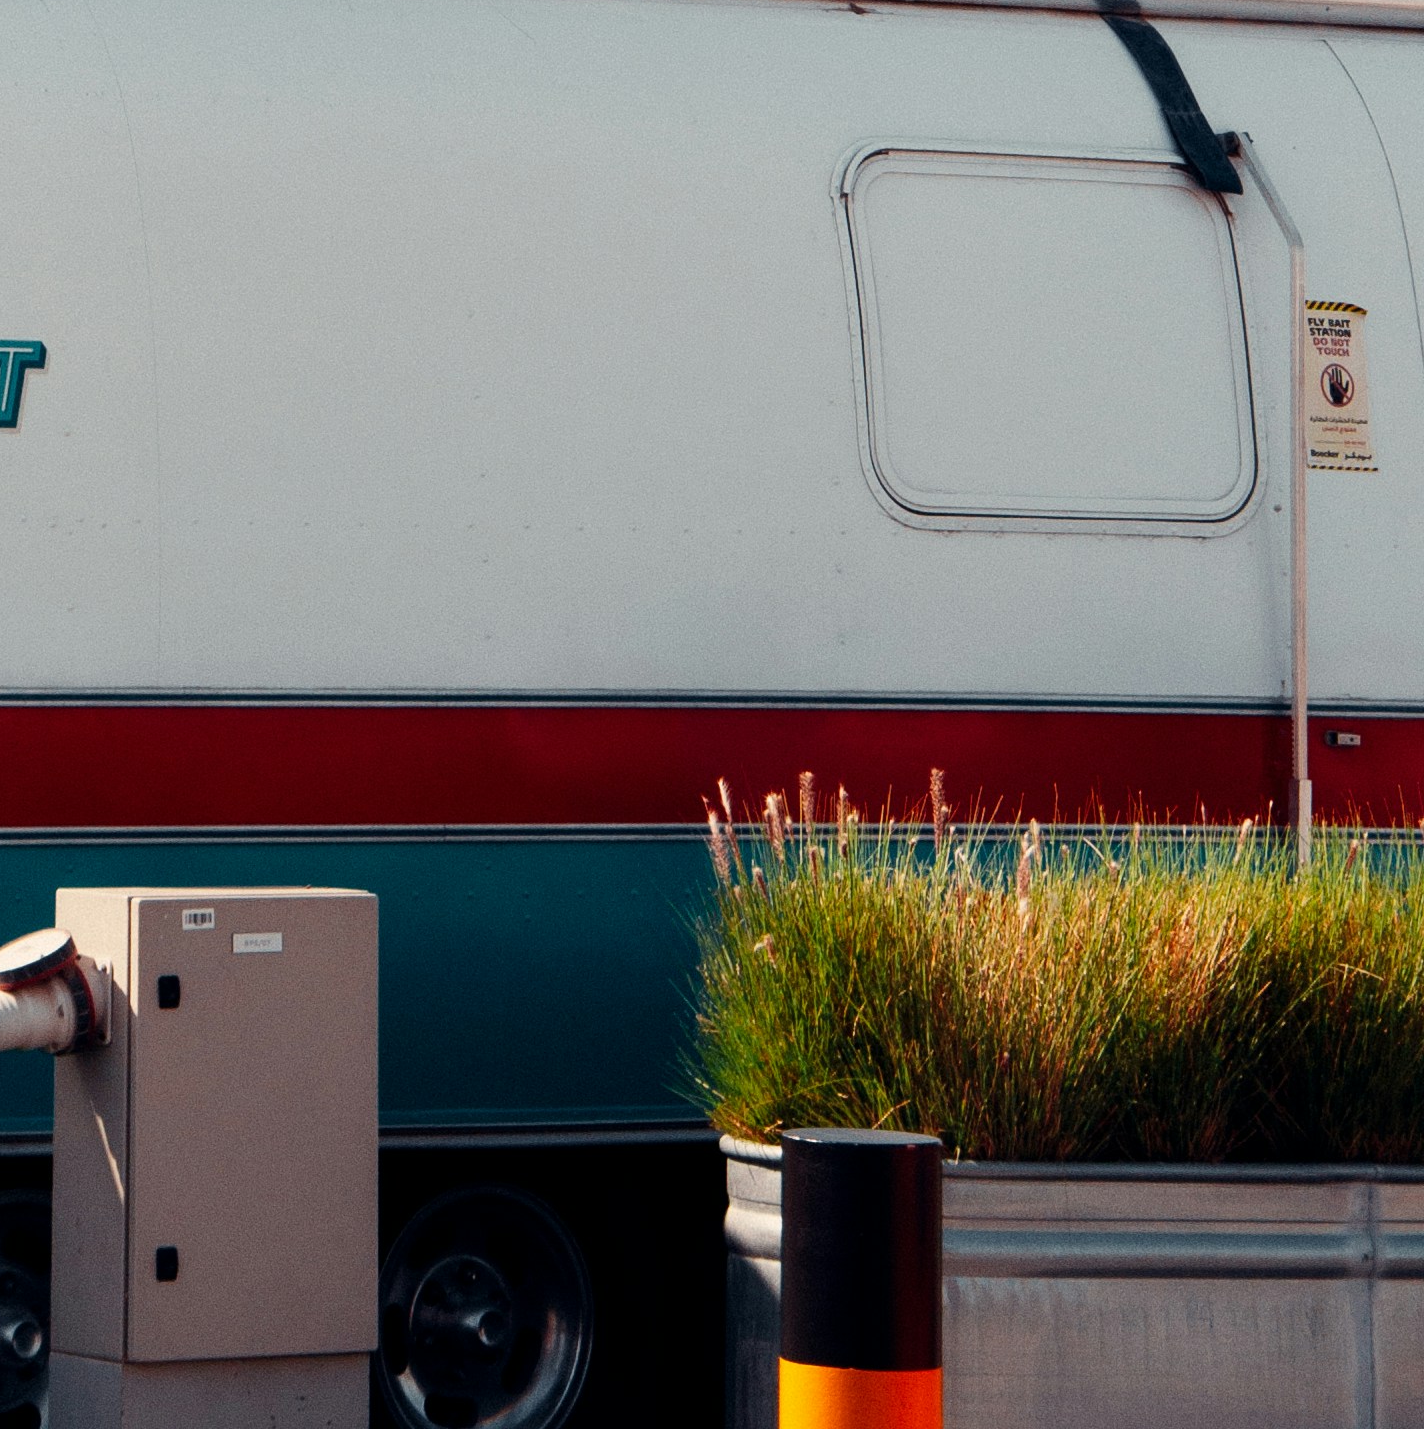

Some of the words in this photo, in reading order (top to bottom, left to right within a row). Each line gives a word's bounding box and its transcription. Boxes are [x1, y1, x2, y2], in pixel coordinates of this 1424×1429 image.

[1307, 317, 1325, 327] FLY
[1328, 318, 1351, 328] BAIT
[1309, 327, 1351, 338] STATION
[1313, 337, 1328, 346] DO
[1331, 338, 1350, 347] NOT
[1316, 347, 1350, 357] TOUCH
